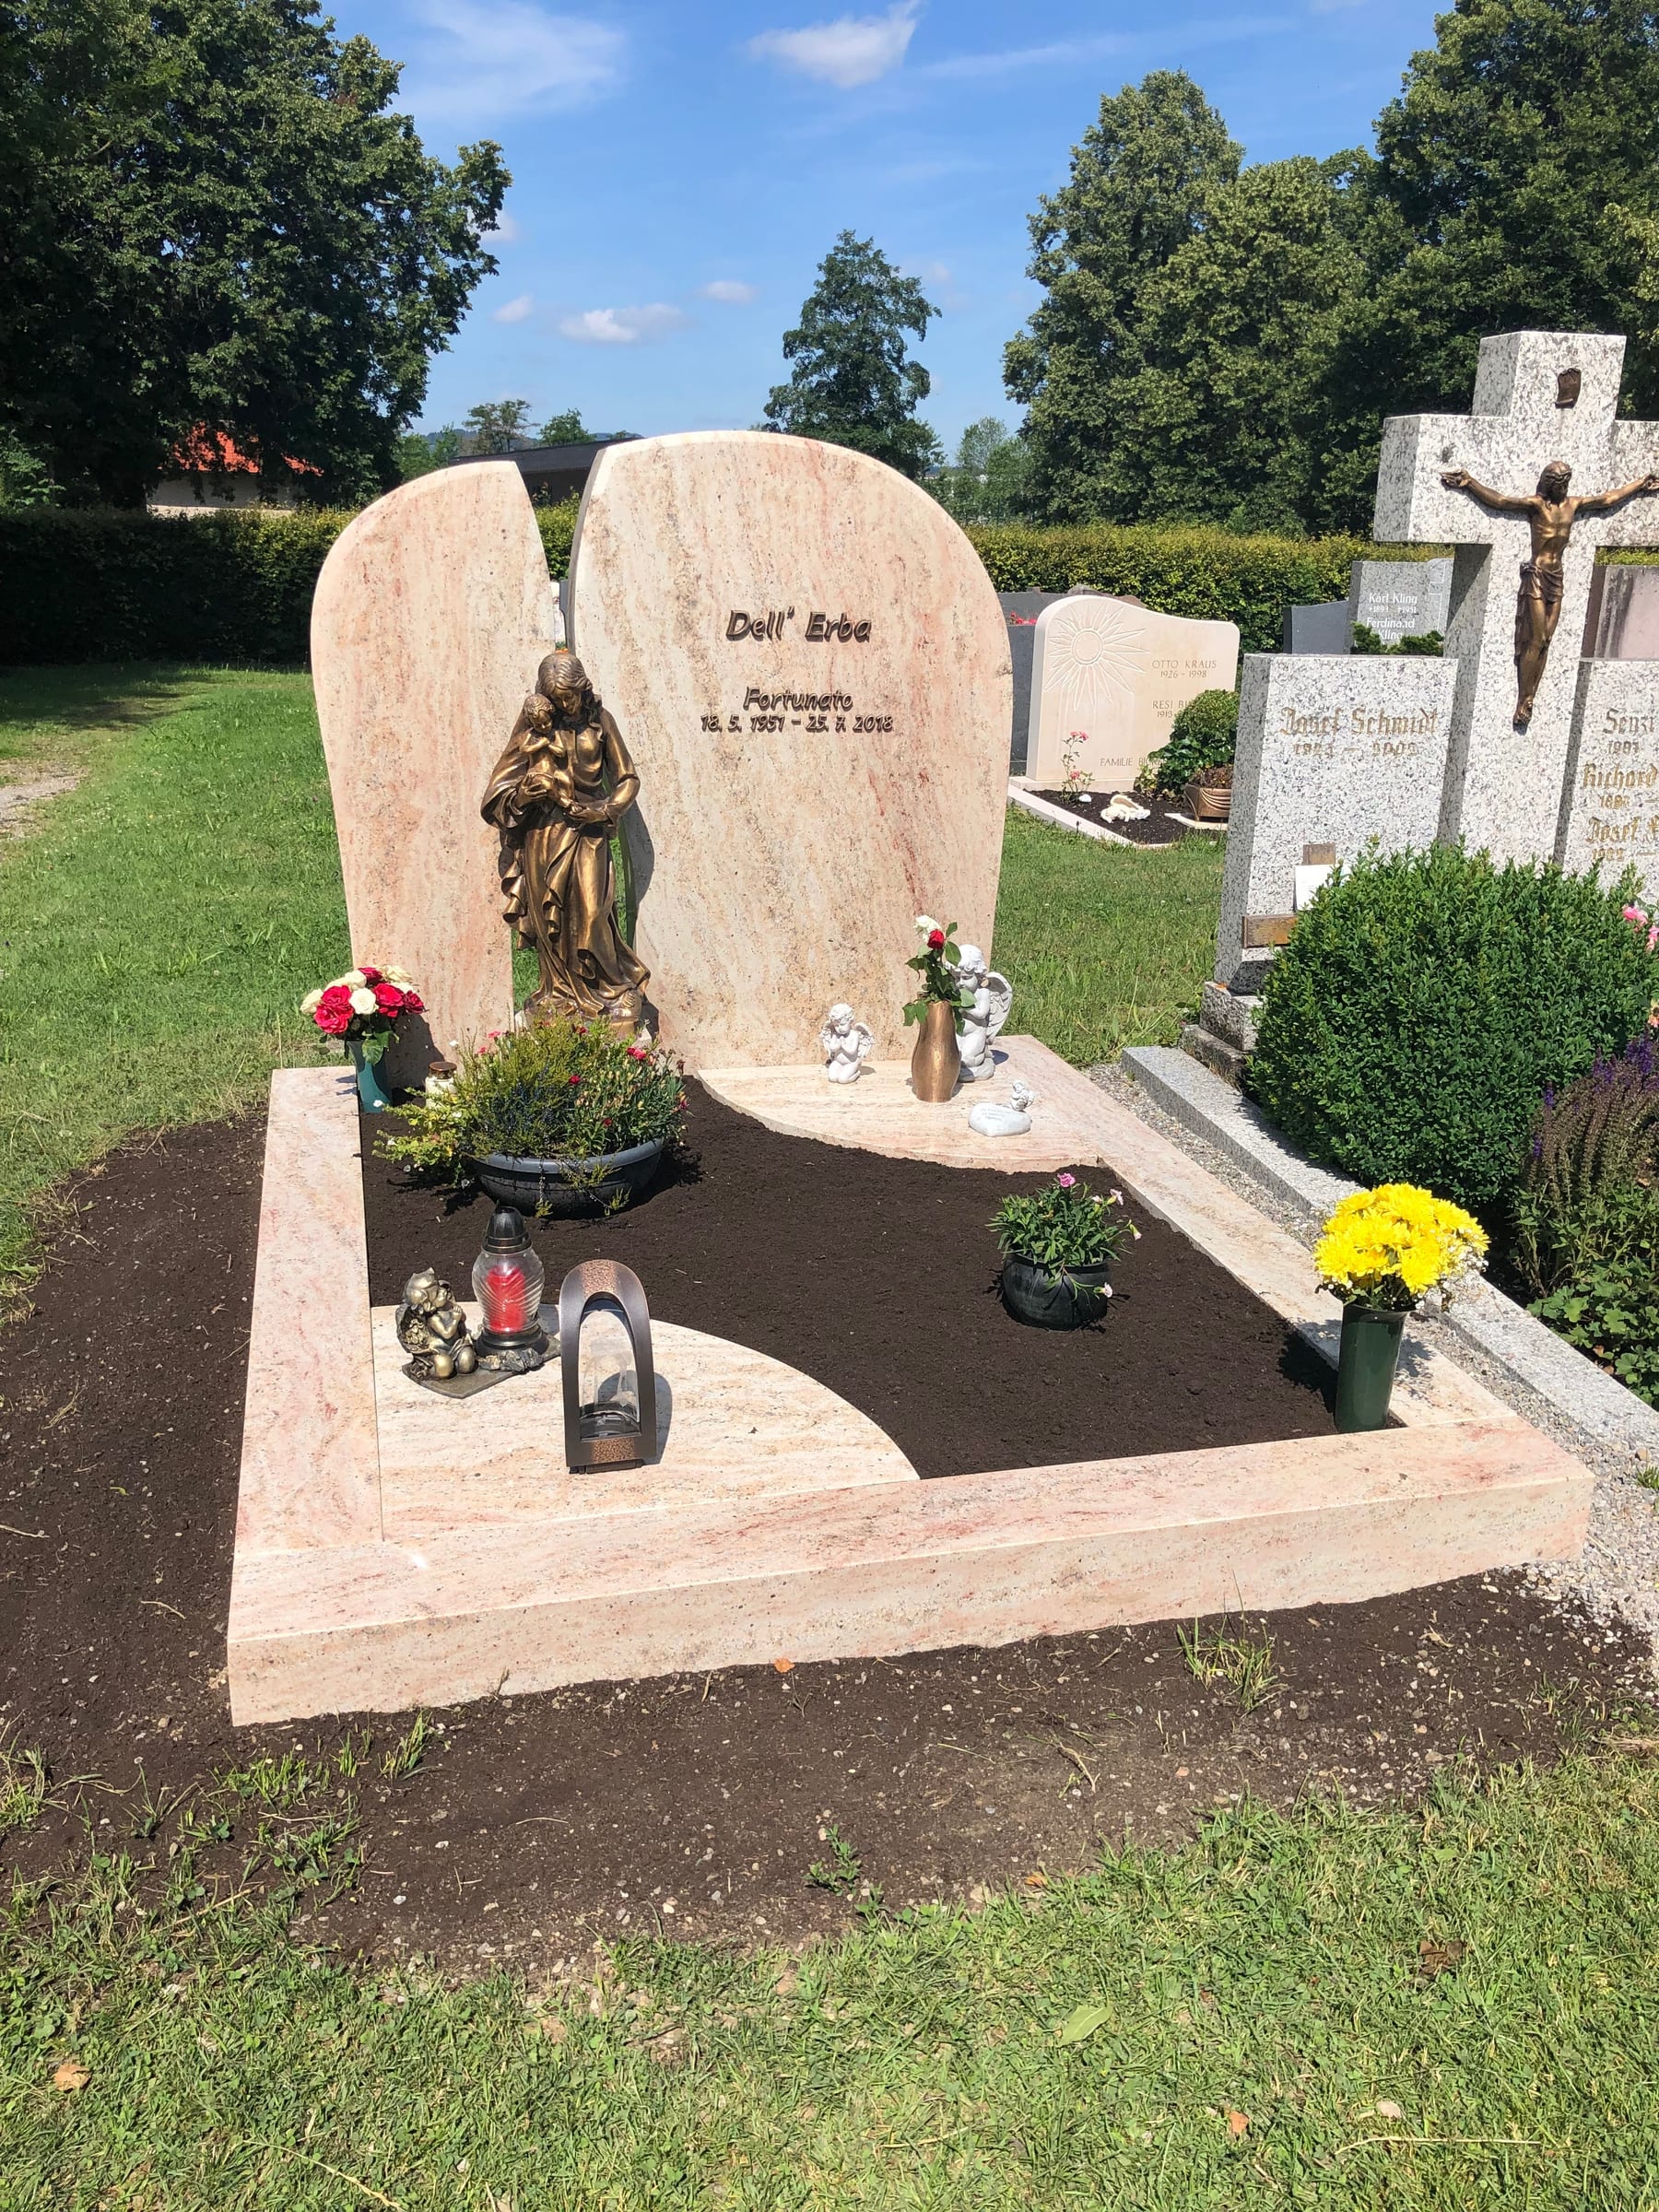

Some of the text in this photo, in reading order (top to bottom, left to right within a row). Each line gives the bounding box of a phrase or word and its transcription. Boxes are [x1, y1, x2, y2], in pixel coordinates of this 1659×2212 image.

[1369, 593, 1418, 606] Karl Kling
[805, 611, 871, 642] Erba
[1366, 617, 1415, 629] Ferdinand
[1151, 659, 1217, 669] OTTO KRAUS
[1160, 670, 1179, 678] 1926
[1189, 670, 1207, 678] 1998
[742, 687, 853, 712] Fortunato
[1152, 700, 1173, 710] RESI
[700, 714, 723, 732] 18.
[727, 714, 743, 733] 5.
[750, 714, 786, 733] 1951
[806, 714, 830, 733] 25.
[853, 714, 894, 733] 2018
[1351, 707, 1439, 736] Schmidt
[1100, 758, 1133, 767] FAMILIE
[1585, 816, 1641, 844] Josef
